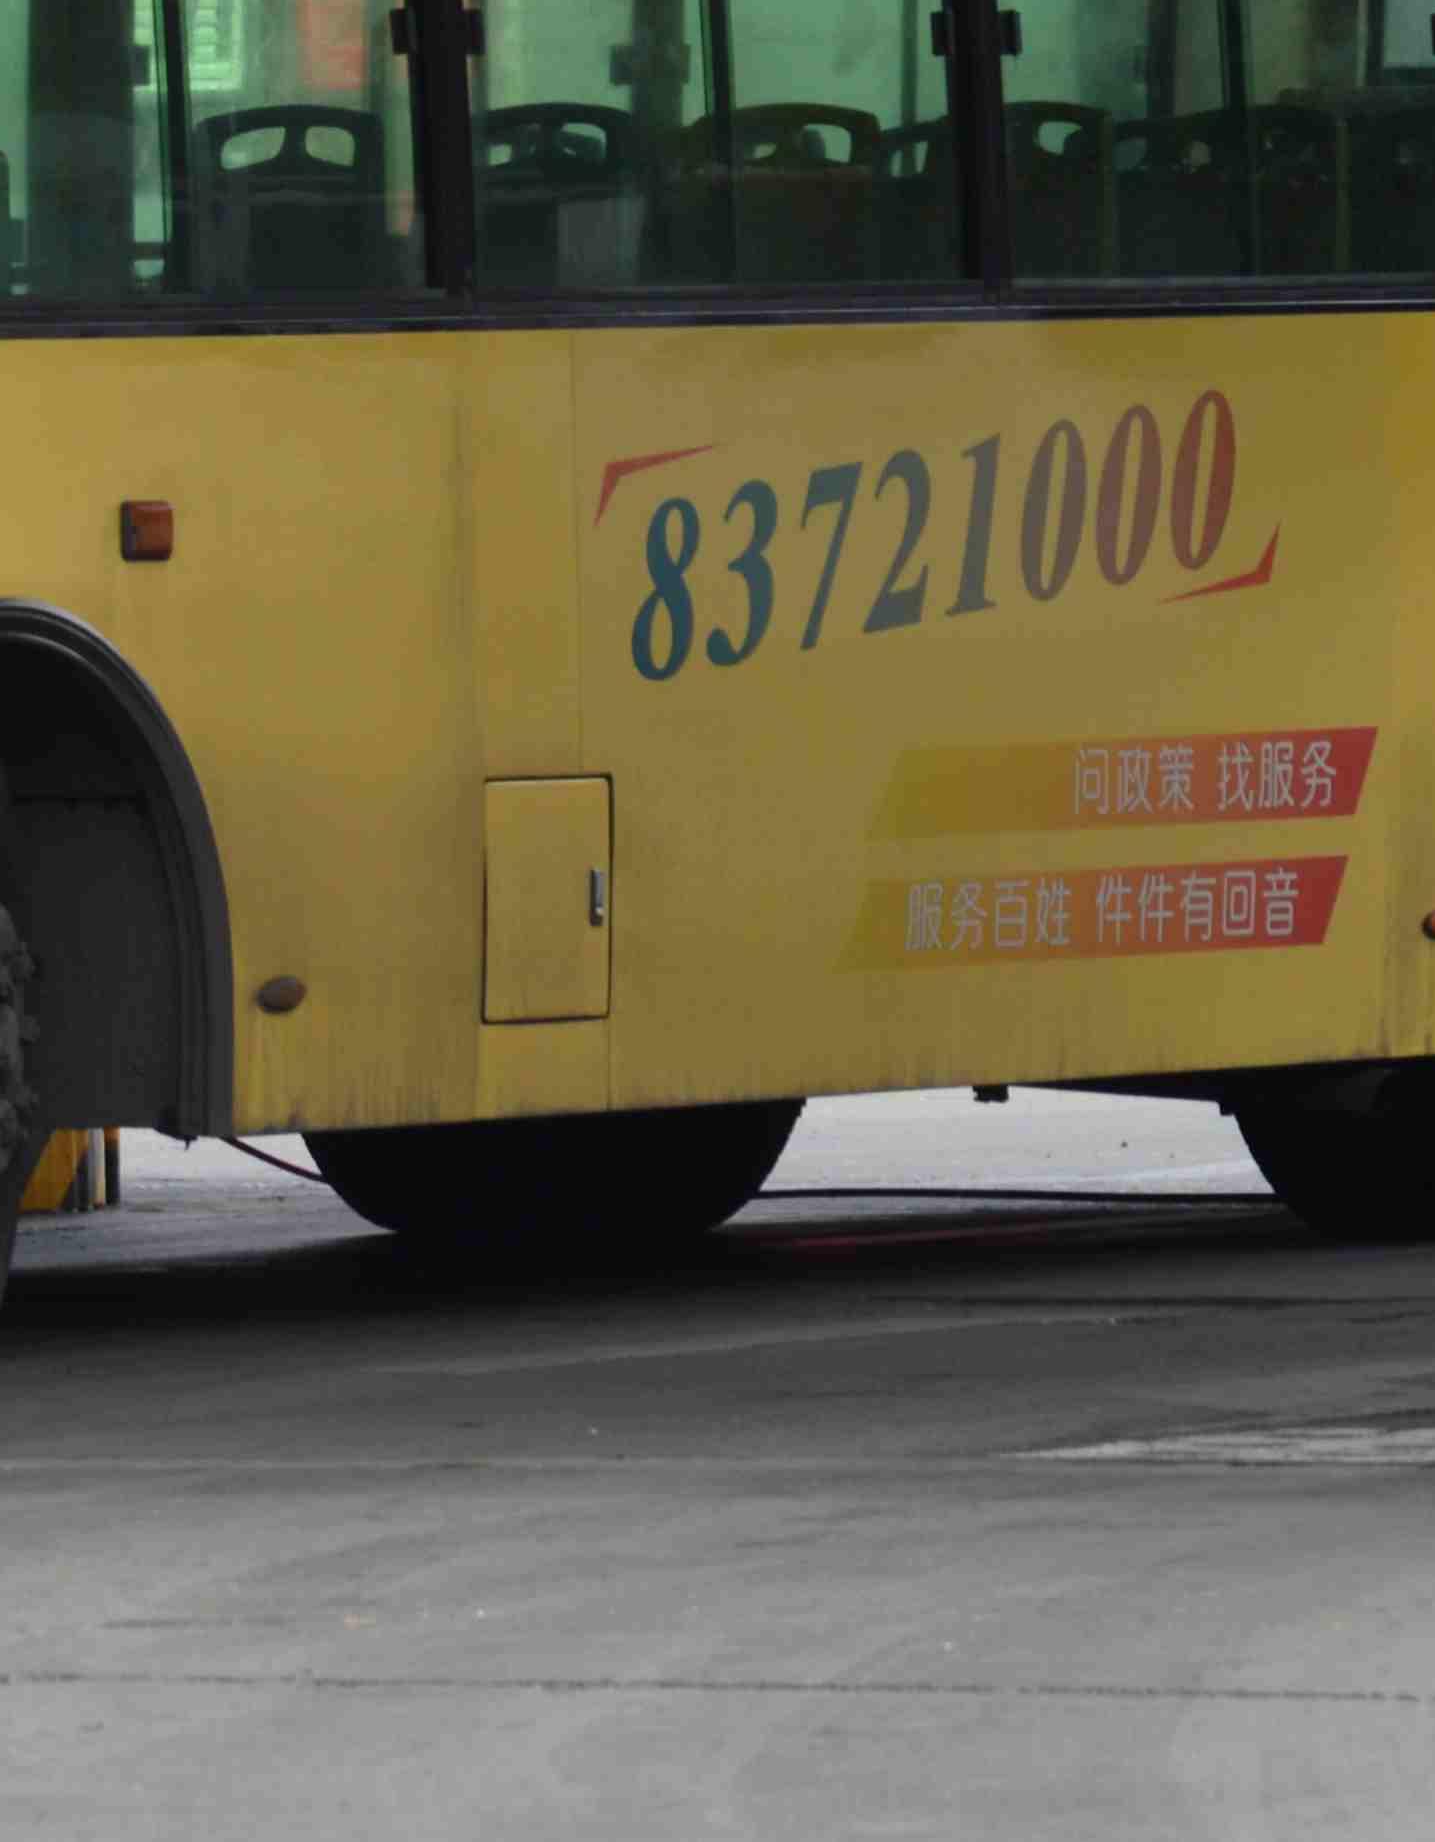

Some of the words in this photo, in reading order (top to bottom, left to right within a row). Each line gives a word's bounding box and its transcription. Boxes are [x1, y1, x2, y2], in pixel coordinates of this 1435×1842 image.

[631, 389, 1236, 682] 83721000
[1073, 743, 1195, 816] 问政策
[1217, 739, 1337, 812] 找服务
[905, 876, 1072, 952] 服务百姓
[1096, 867, 1300, 945] 件件有回音
